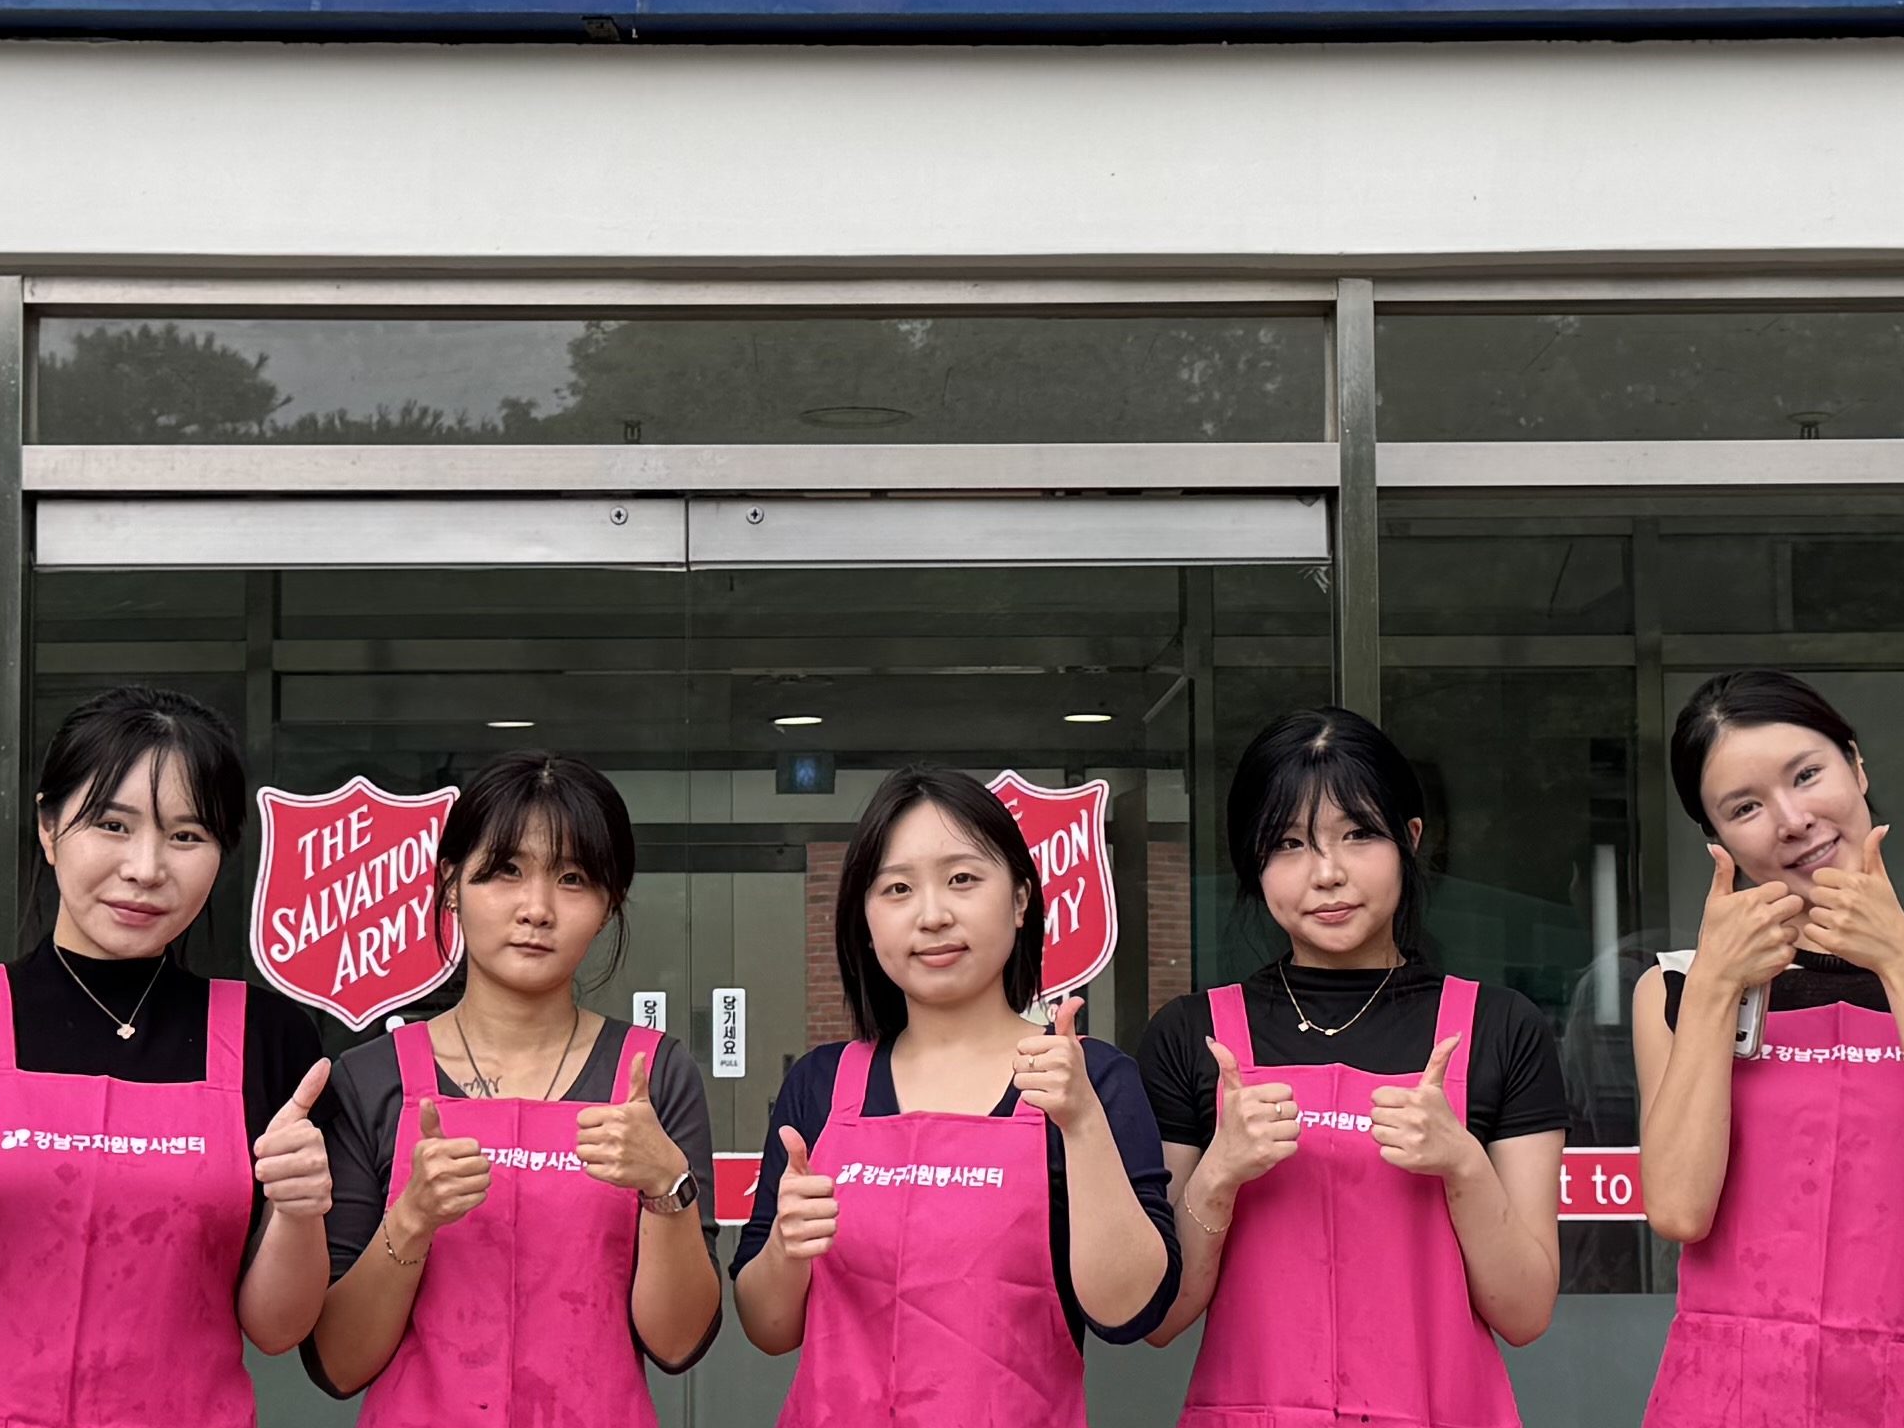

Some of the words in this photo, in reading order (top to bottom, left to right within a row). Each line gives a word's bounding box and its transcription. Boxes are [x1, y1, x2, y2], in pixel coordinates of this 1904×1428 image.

[297, 804, 374, 881] THE
[270, 816, 439, 963] SALVATION
[330, 885, 435, 997] ARMY
[723, 996, 736, 1055] 당기세요
[34, 1130, 206, 1155] 강남구자원봉사센터
[862, 1164, 1004, 1188] 강남구자원봉사센터
[1591, 1164, 1633, 1205] to
